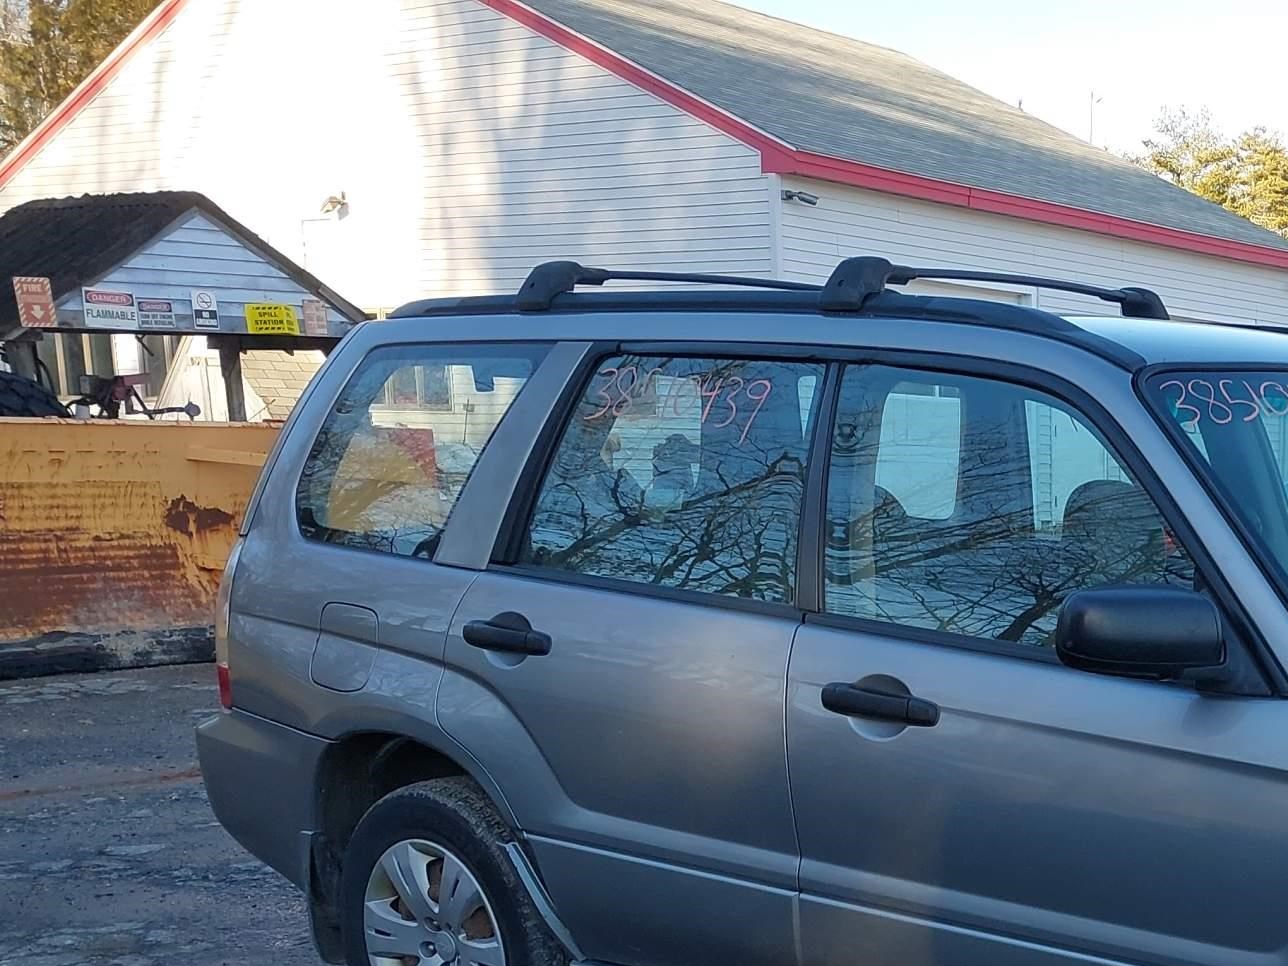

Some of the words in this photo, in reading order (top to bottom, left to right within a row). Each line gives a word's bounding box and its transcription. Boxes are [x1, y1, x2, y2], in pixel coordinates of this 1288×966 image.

[22, 283, 42, 293] FIRE
[91, 292, 127, 304] DANGER
[85, 308, 137, 321] FLAMMABLE
